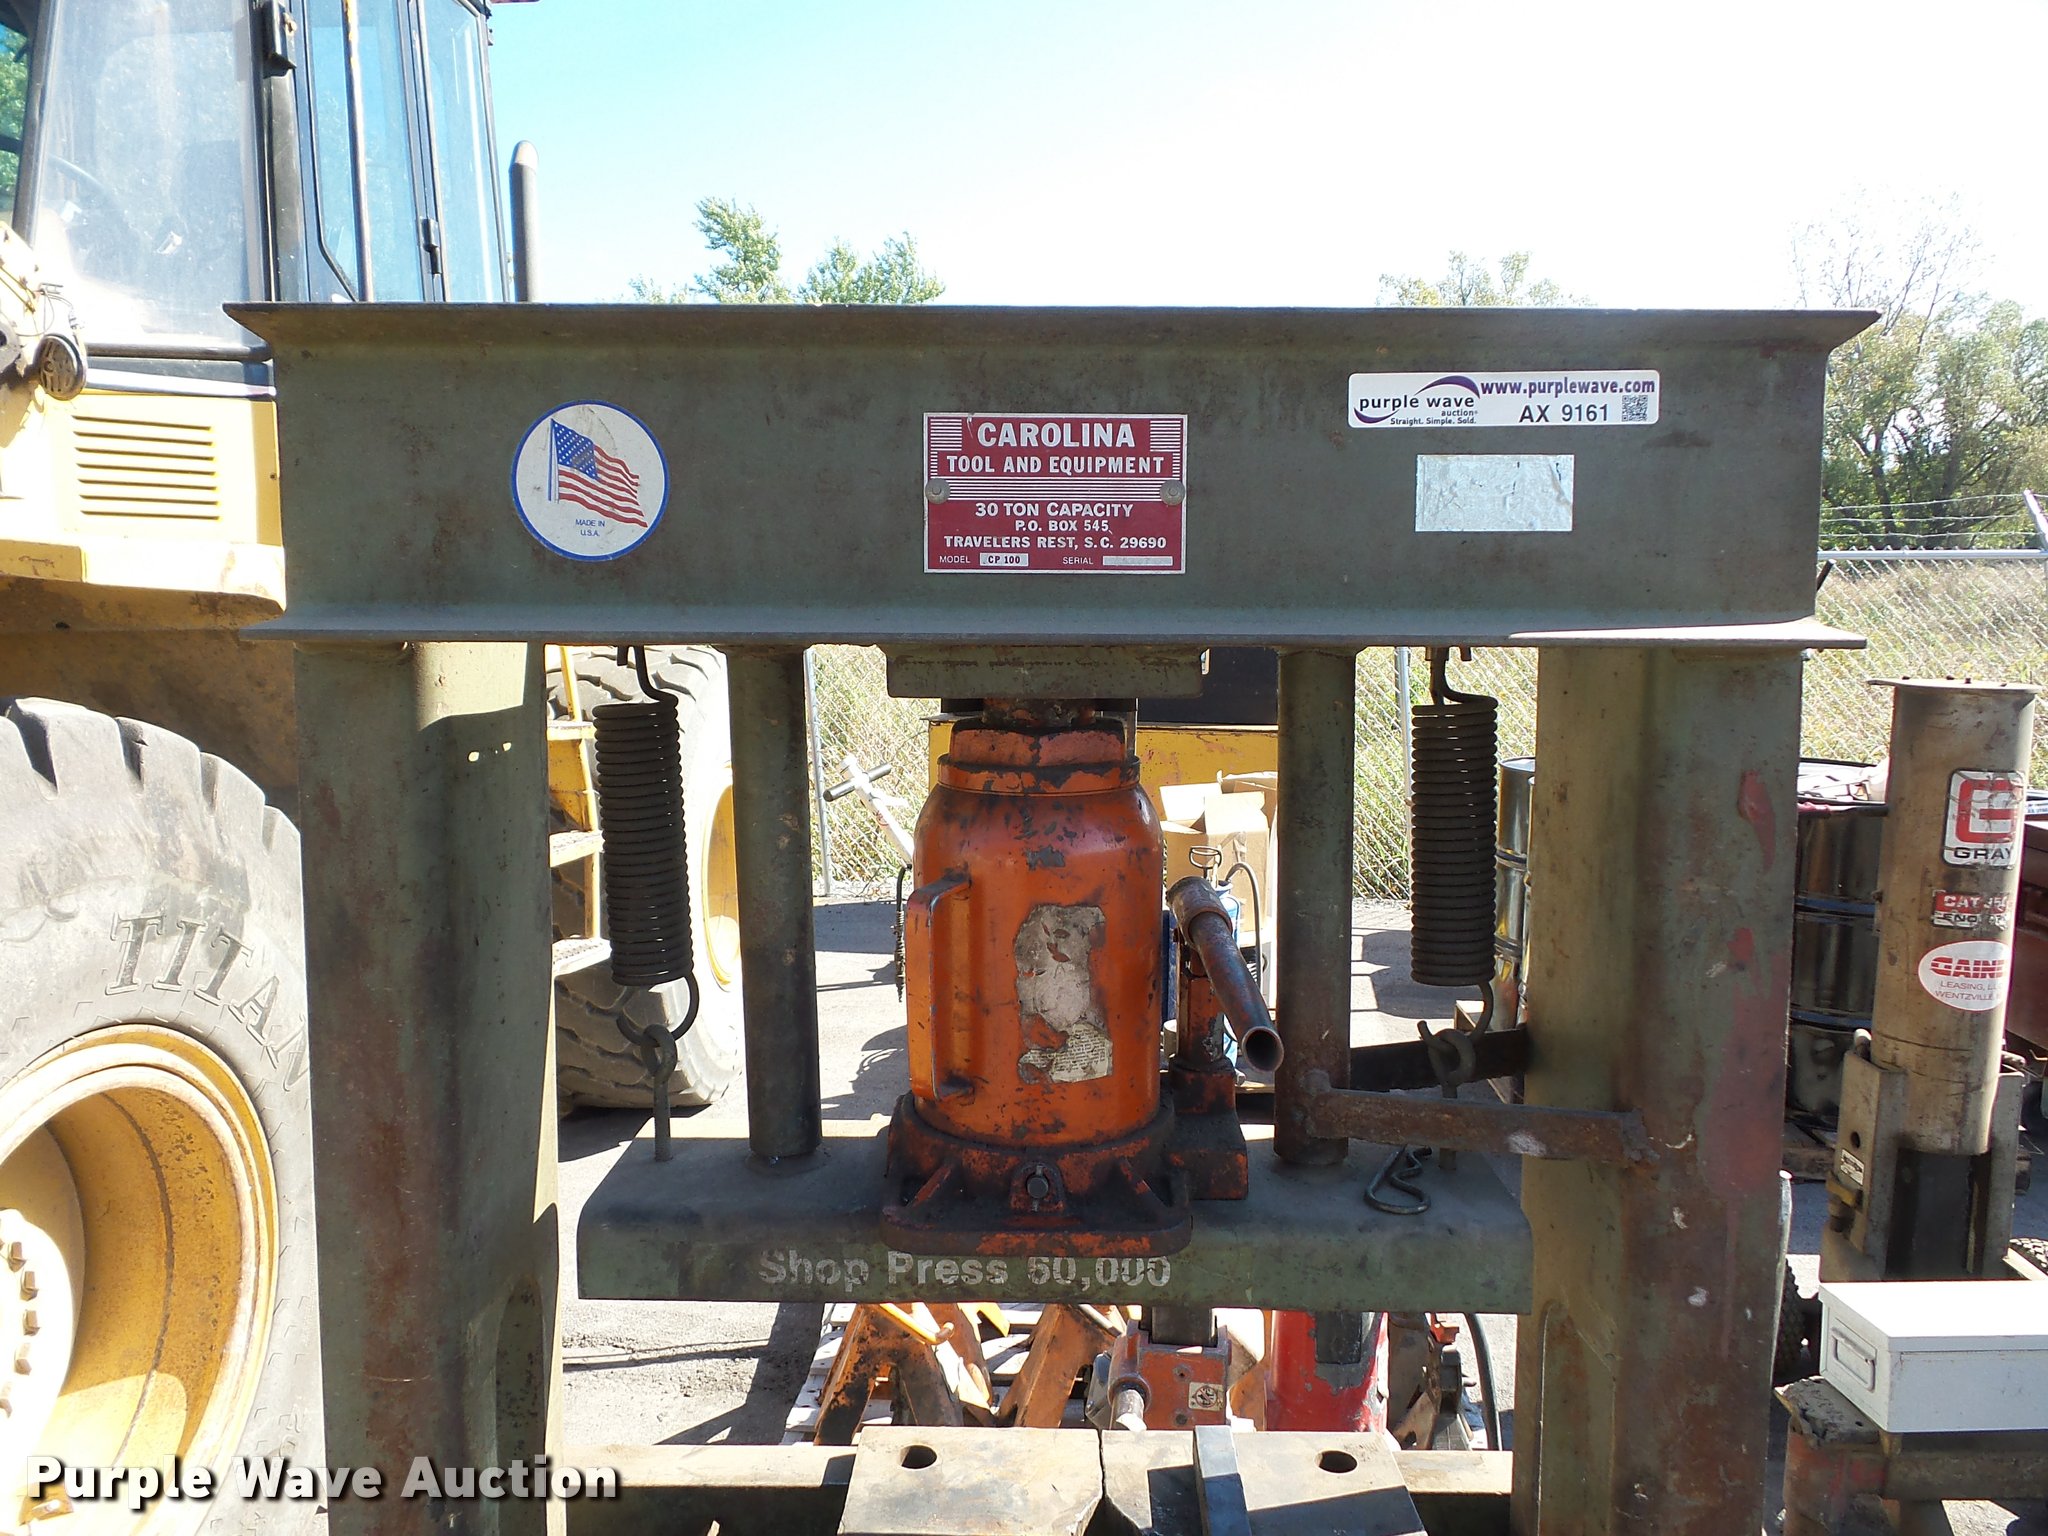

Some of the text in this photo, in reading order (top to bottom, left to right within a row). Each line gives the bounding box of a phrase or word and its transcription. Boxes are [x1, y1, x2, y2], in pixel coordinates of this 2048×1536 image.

[1480, 377, 1655, 398] www.purplewave.com
[1360, 394, 1475, 411] purple wave
[1441, 409, 1474, 417] auction
[1519, 404, 1609, 423] AX 9161
[1390, 416, 1477, 426] Straight. Simple. Sold.
[977, 422, 1136, 448] CAROLINA
[947, 455, 1164, 476] TOOL AND EQUIPMENT
[975, 502, 1134, 518] 30 TON CAPACITY
[575, 518, 596, 526] MADE
[1015, 520, 1042, 532] P.O.
[1048, 520, 1078, 532] BOX
[944, 535, 1031, 548] TRAVELERS
[1037, 536, 1079, 550] REST,
[1120, 537, 1167, 549] 29690
[939, 555, 1021, 564] MODEL CP 100
[1062, 556, 1093, 565] SERIAL
[758, 1249, 870, 1292] Shop
[887, 1250, 1009, 1285] Press
